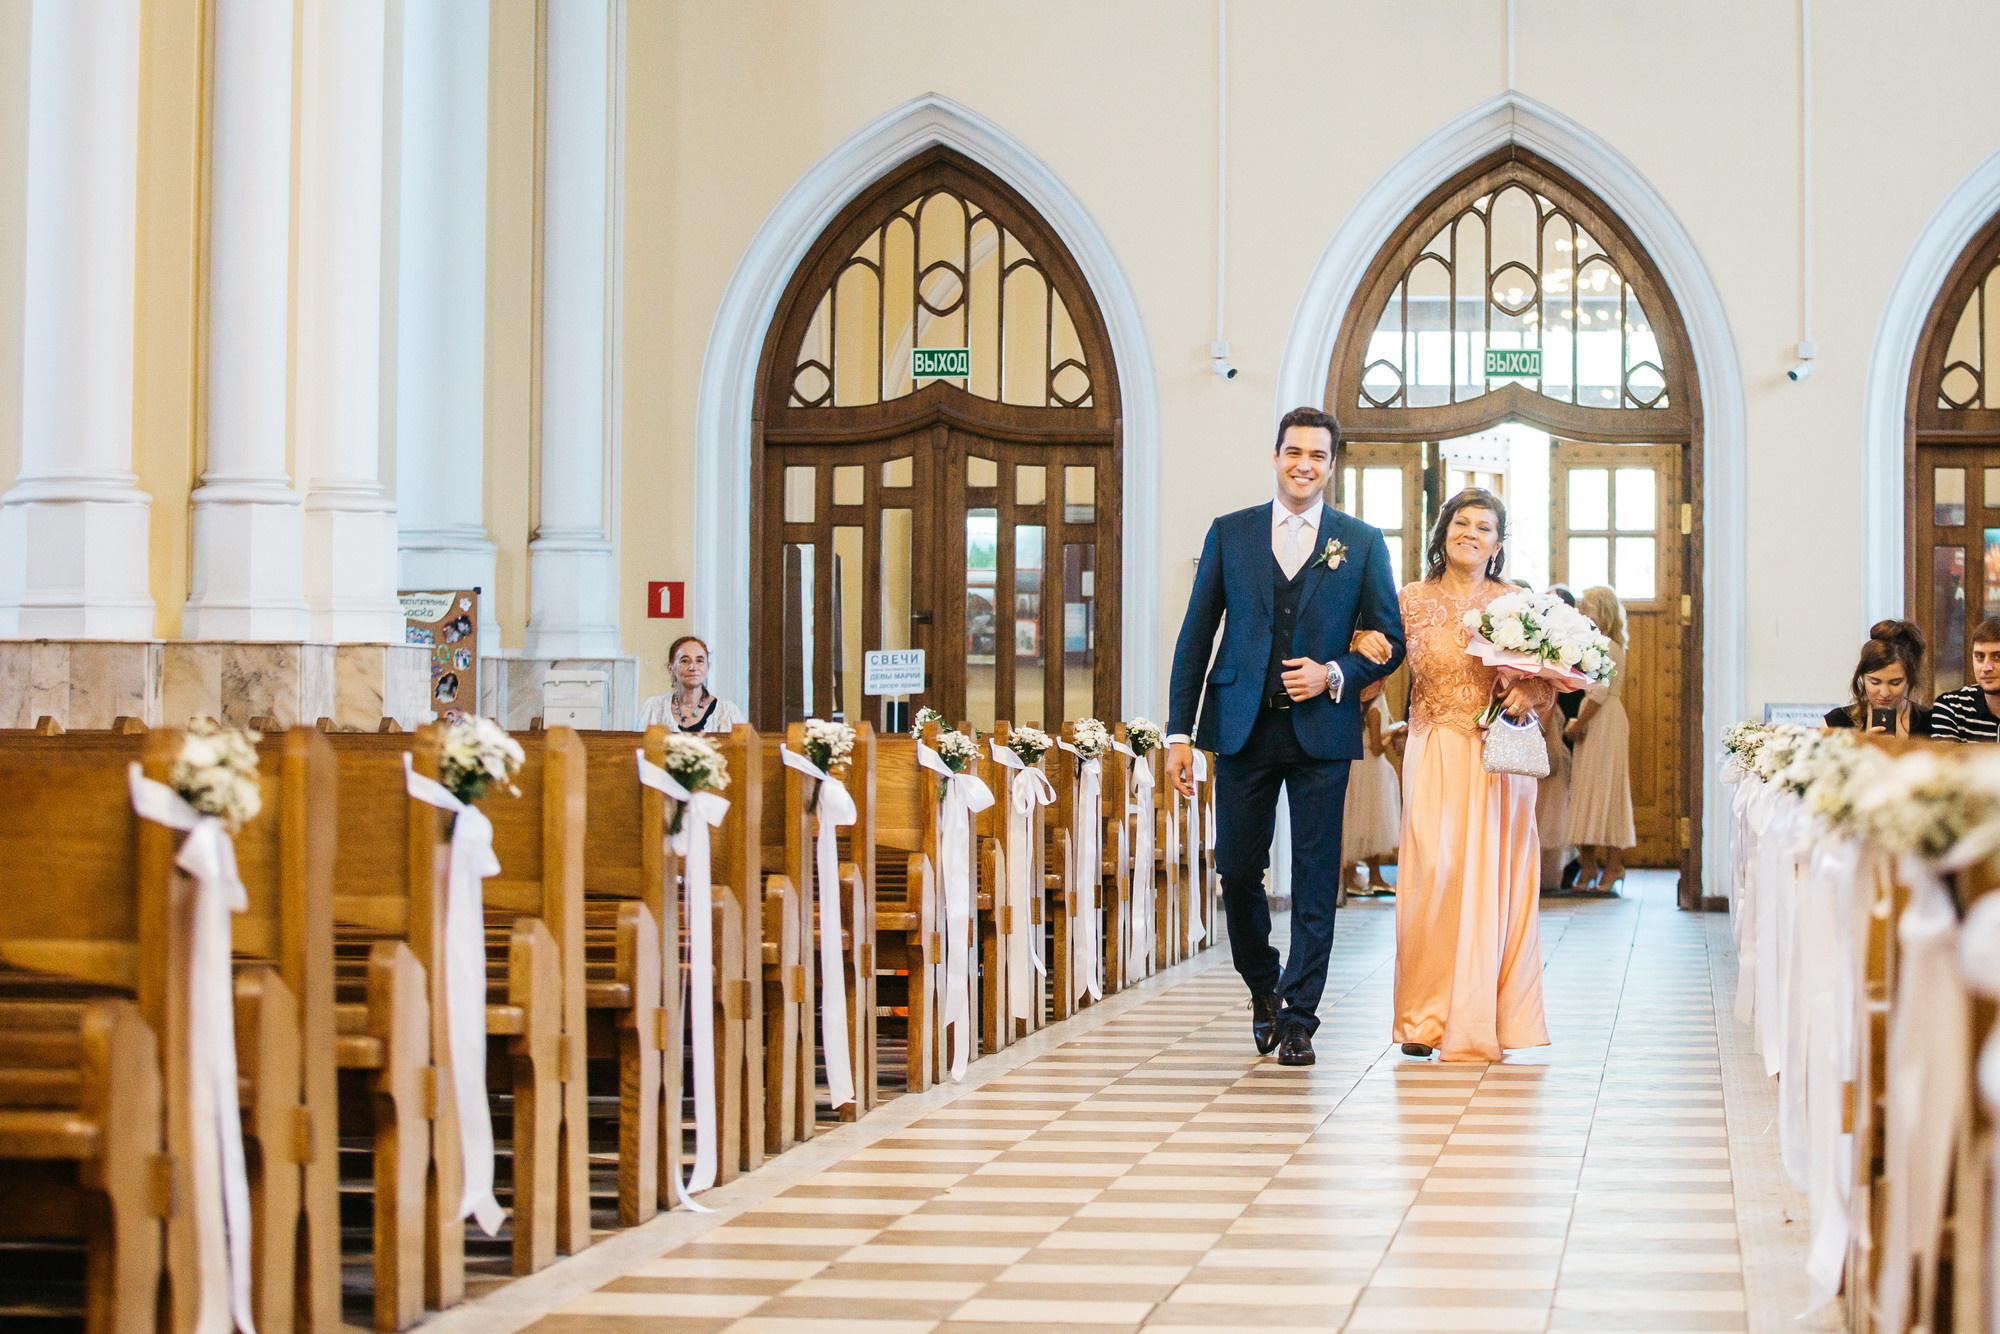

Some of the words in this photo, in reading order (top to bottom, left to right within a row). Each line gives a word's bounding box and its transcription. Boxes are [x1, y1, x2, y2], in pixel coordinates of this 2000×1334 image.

[915, 352, 967, 373] ВЫХОД
[1487, 353, 1540, 374] ВЫХОД
[870, 653, 919, 665] СВЕЧИ
[870, 673, 893, 681] ДЕВЫ
[894, 672, 921, 680] МАРИИ
